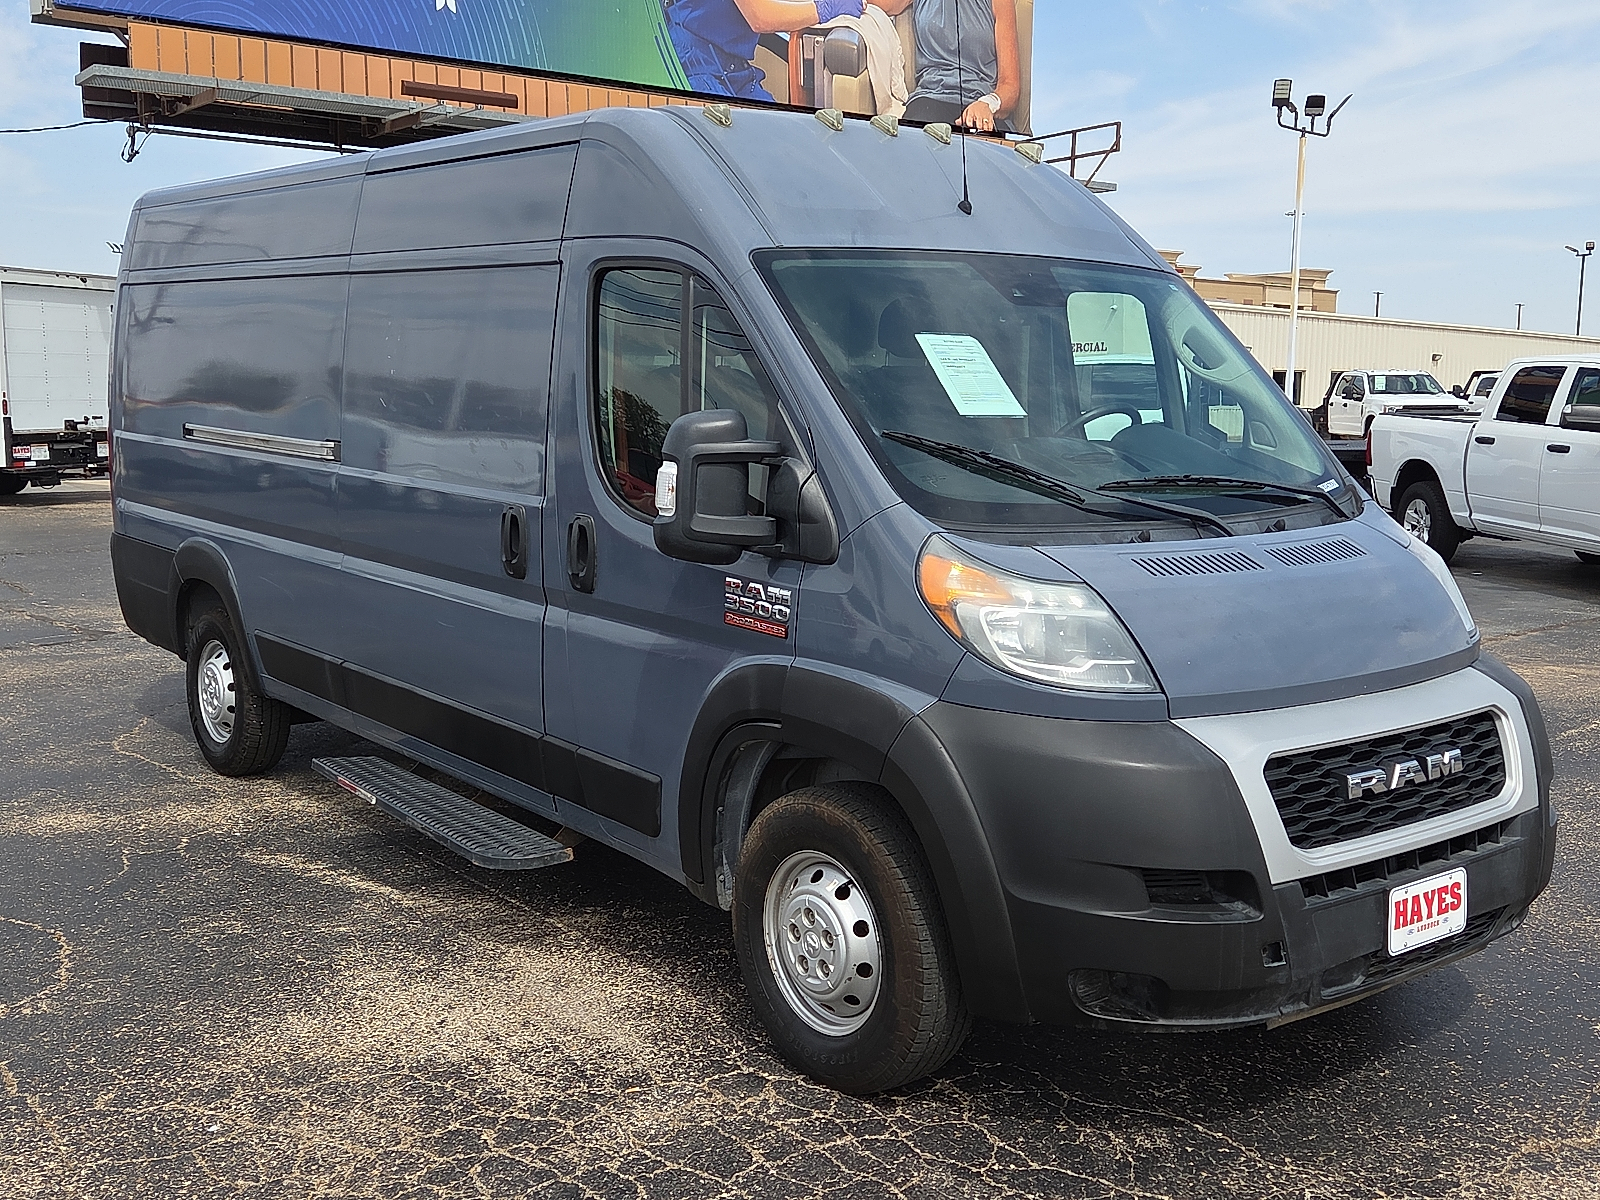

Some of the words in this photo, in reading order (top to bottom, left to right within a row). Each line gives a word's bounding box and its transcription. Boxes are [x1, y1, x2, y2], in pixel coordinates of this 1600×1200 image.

[724, 576, 792, 606] RAM
[724, 592, 791, 622] 3500
[1347, 748, 1463, 800] RAM
[1394, 881, 1462, 931] HAYES
